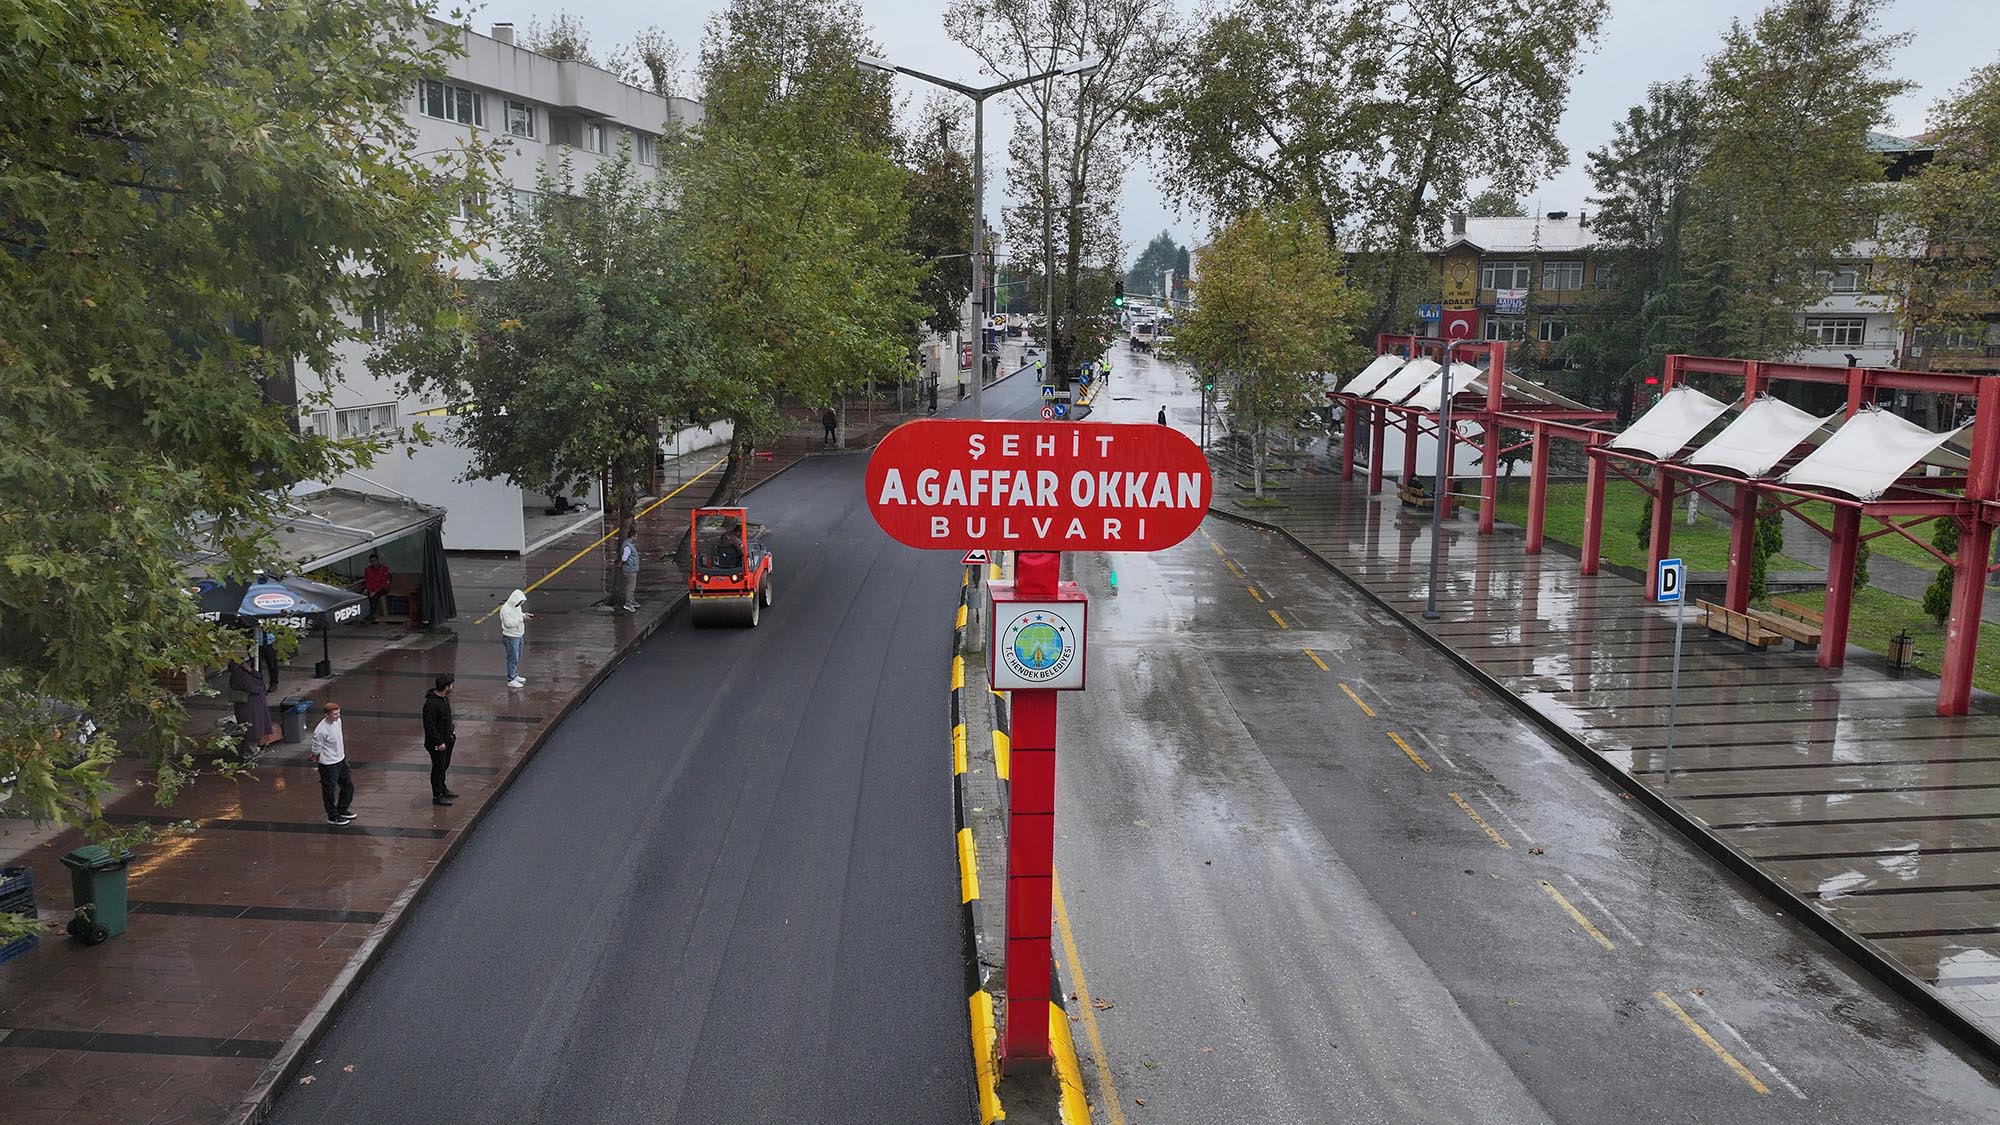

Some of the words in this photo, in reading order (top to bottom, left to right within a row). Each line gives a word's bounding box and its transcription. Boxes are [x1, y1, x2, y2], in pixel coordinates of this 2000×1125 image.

[968, 430, 1115, 460] ŞEHİT
[878, 468, 1059, 508] A.GAFFAR
[1070, 471, 1201, 509] OKKAN
[930, 516, 1145, 540] BULVARI
[1663, 568, 1677, 592] D
[334, 603, 361, 622] PEPSI
[1009, 660, 1039, 679] HENDEK
[1040, 645, 1072, 679] BELEDİYESİ
